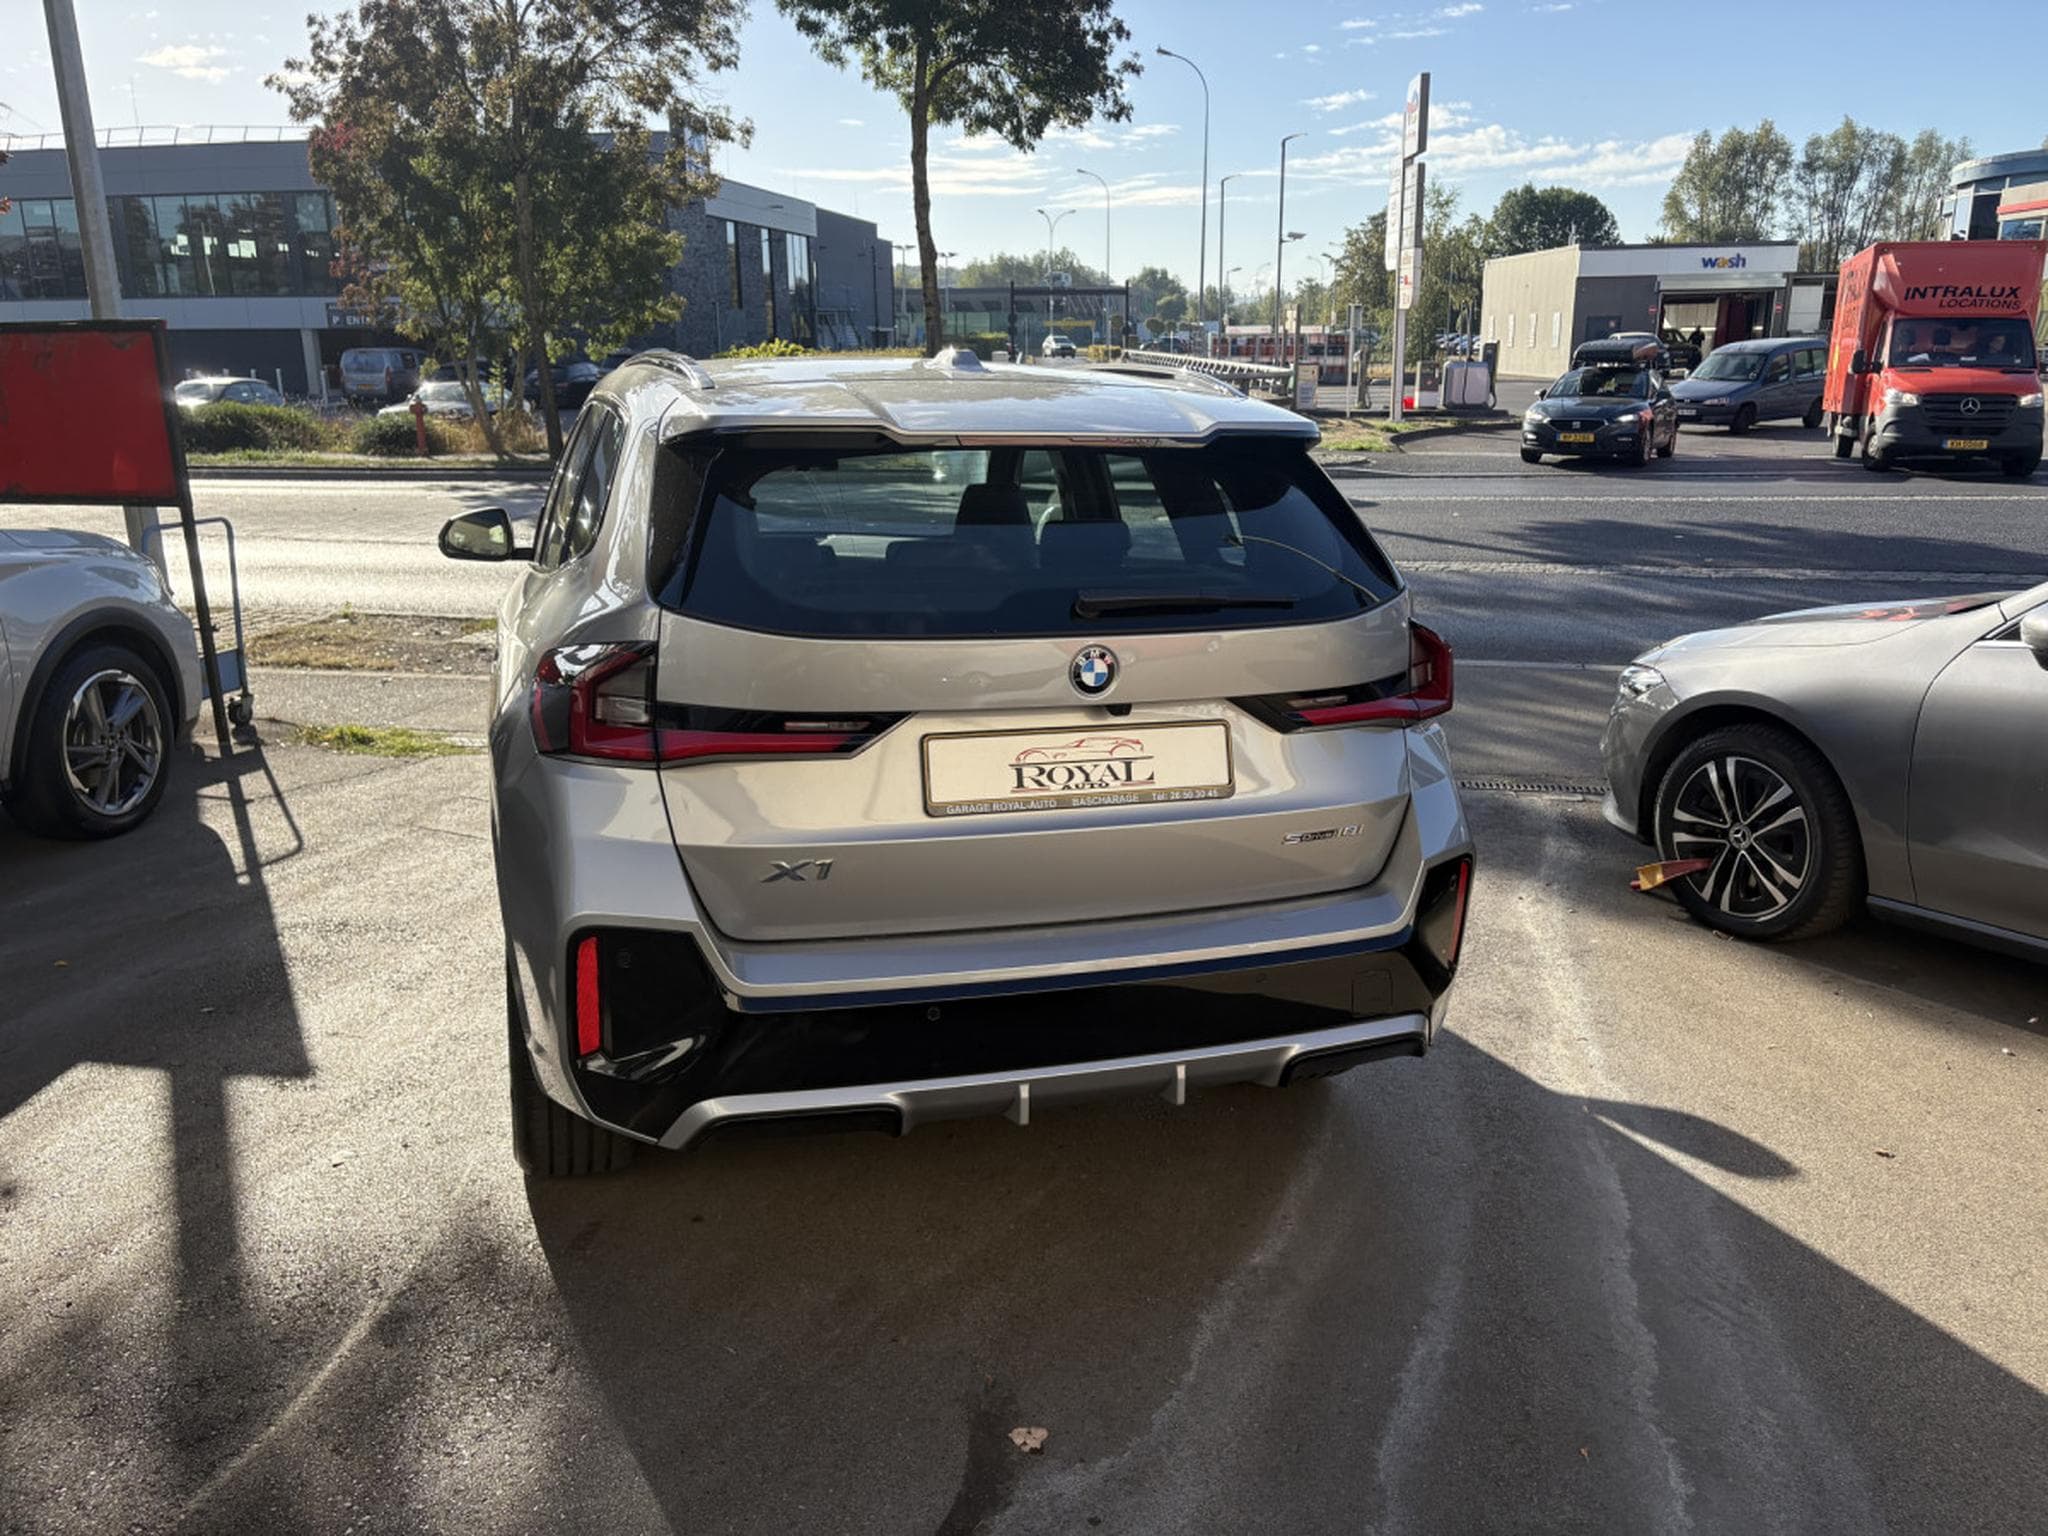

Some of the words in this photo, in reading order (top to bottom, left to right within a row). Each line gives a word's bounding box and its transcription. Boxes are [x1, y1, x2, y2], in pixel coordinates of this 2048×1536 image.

[1701, 253, 1747, 269] wash
[1904, 285, 2021, 301] INTRALUX
[1938, 298, 2021, 310] LOCATIONS
[1076, 648, 1112, 665] BMW
[1013, 760, 1155, 789] ROYAL
[1062, 782, 1110, 791] AUTO
[946, 803, 991, 815] GARAGE
[760, 858, 834, 884] X1
